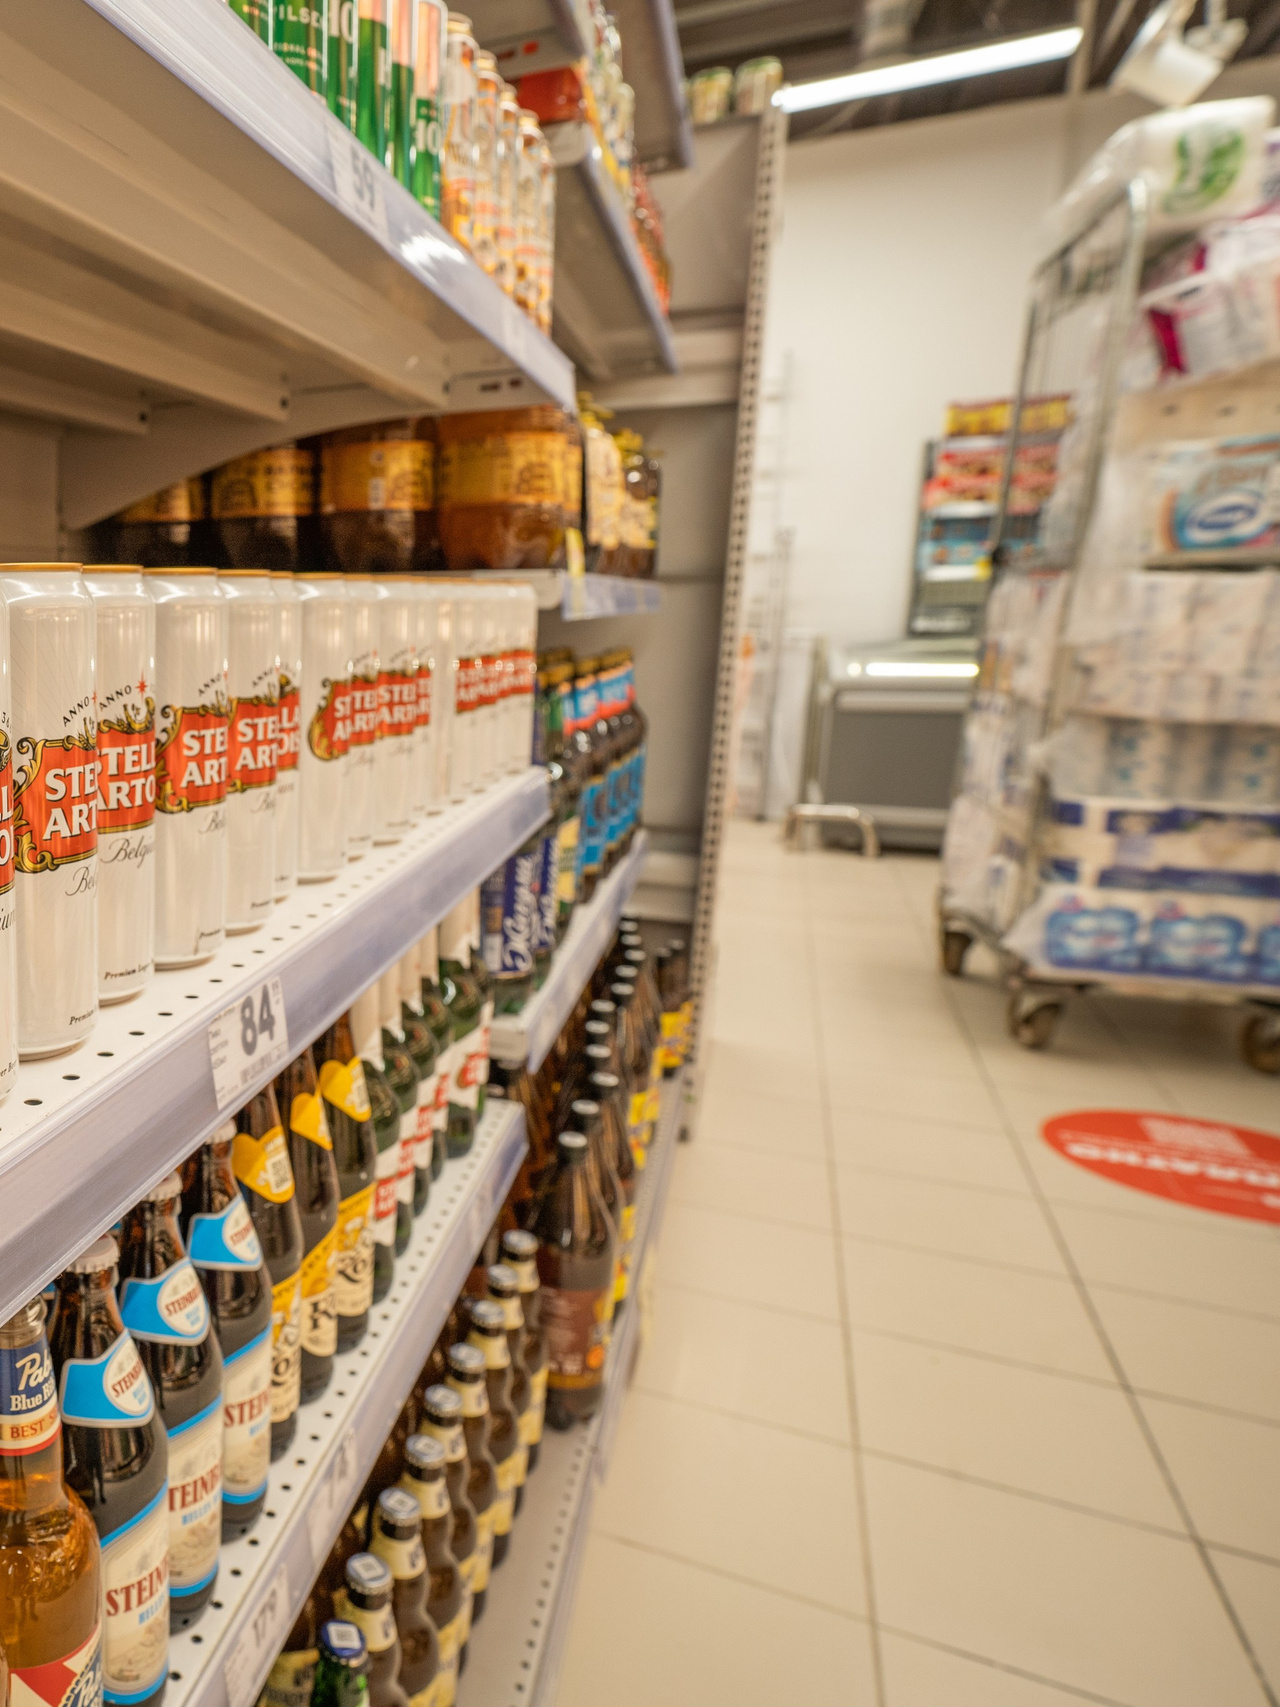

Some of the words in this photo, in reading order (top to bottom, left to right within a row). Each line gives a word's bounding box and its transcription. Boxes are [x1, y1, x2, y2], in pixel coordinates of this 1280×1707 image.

[62, 696, 90, 728] ANNO
[98, 683, 133, 712] ANNO
[240, 983, 276, 1057] 84
[9, 1393, 44, 1412] Blue
[9, 1418, 46, 1440] BEST
